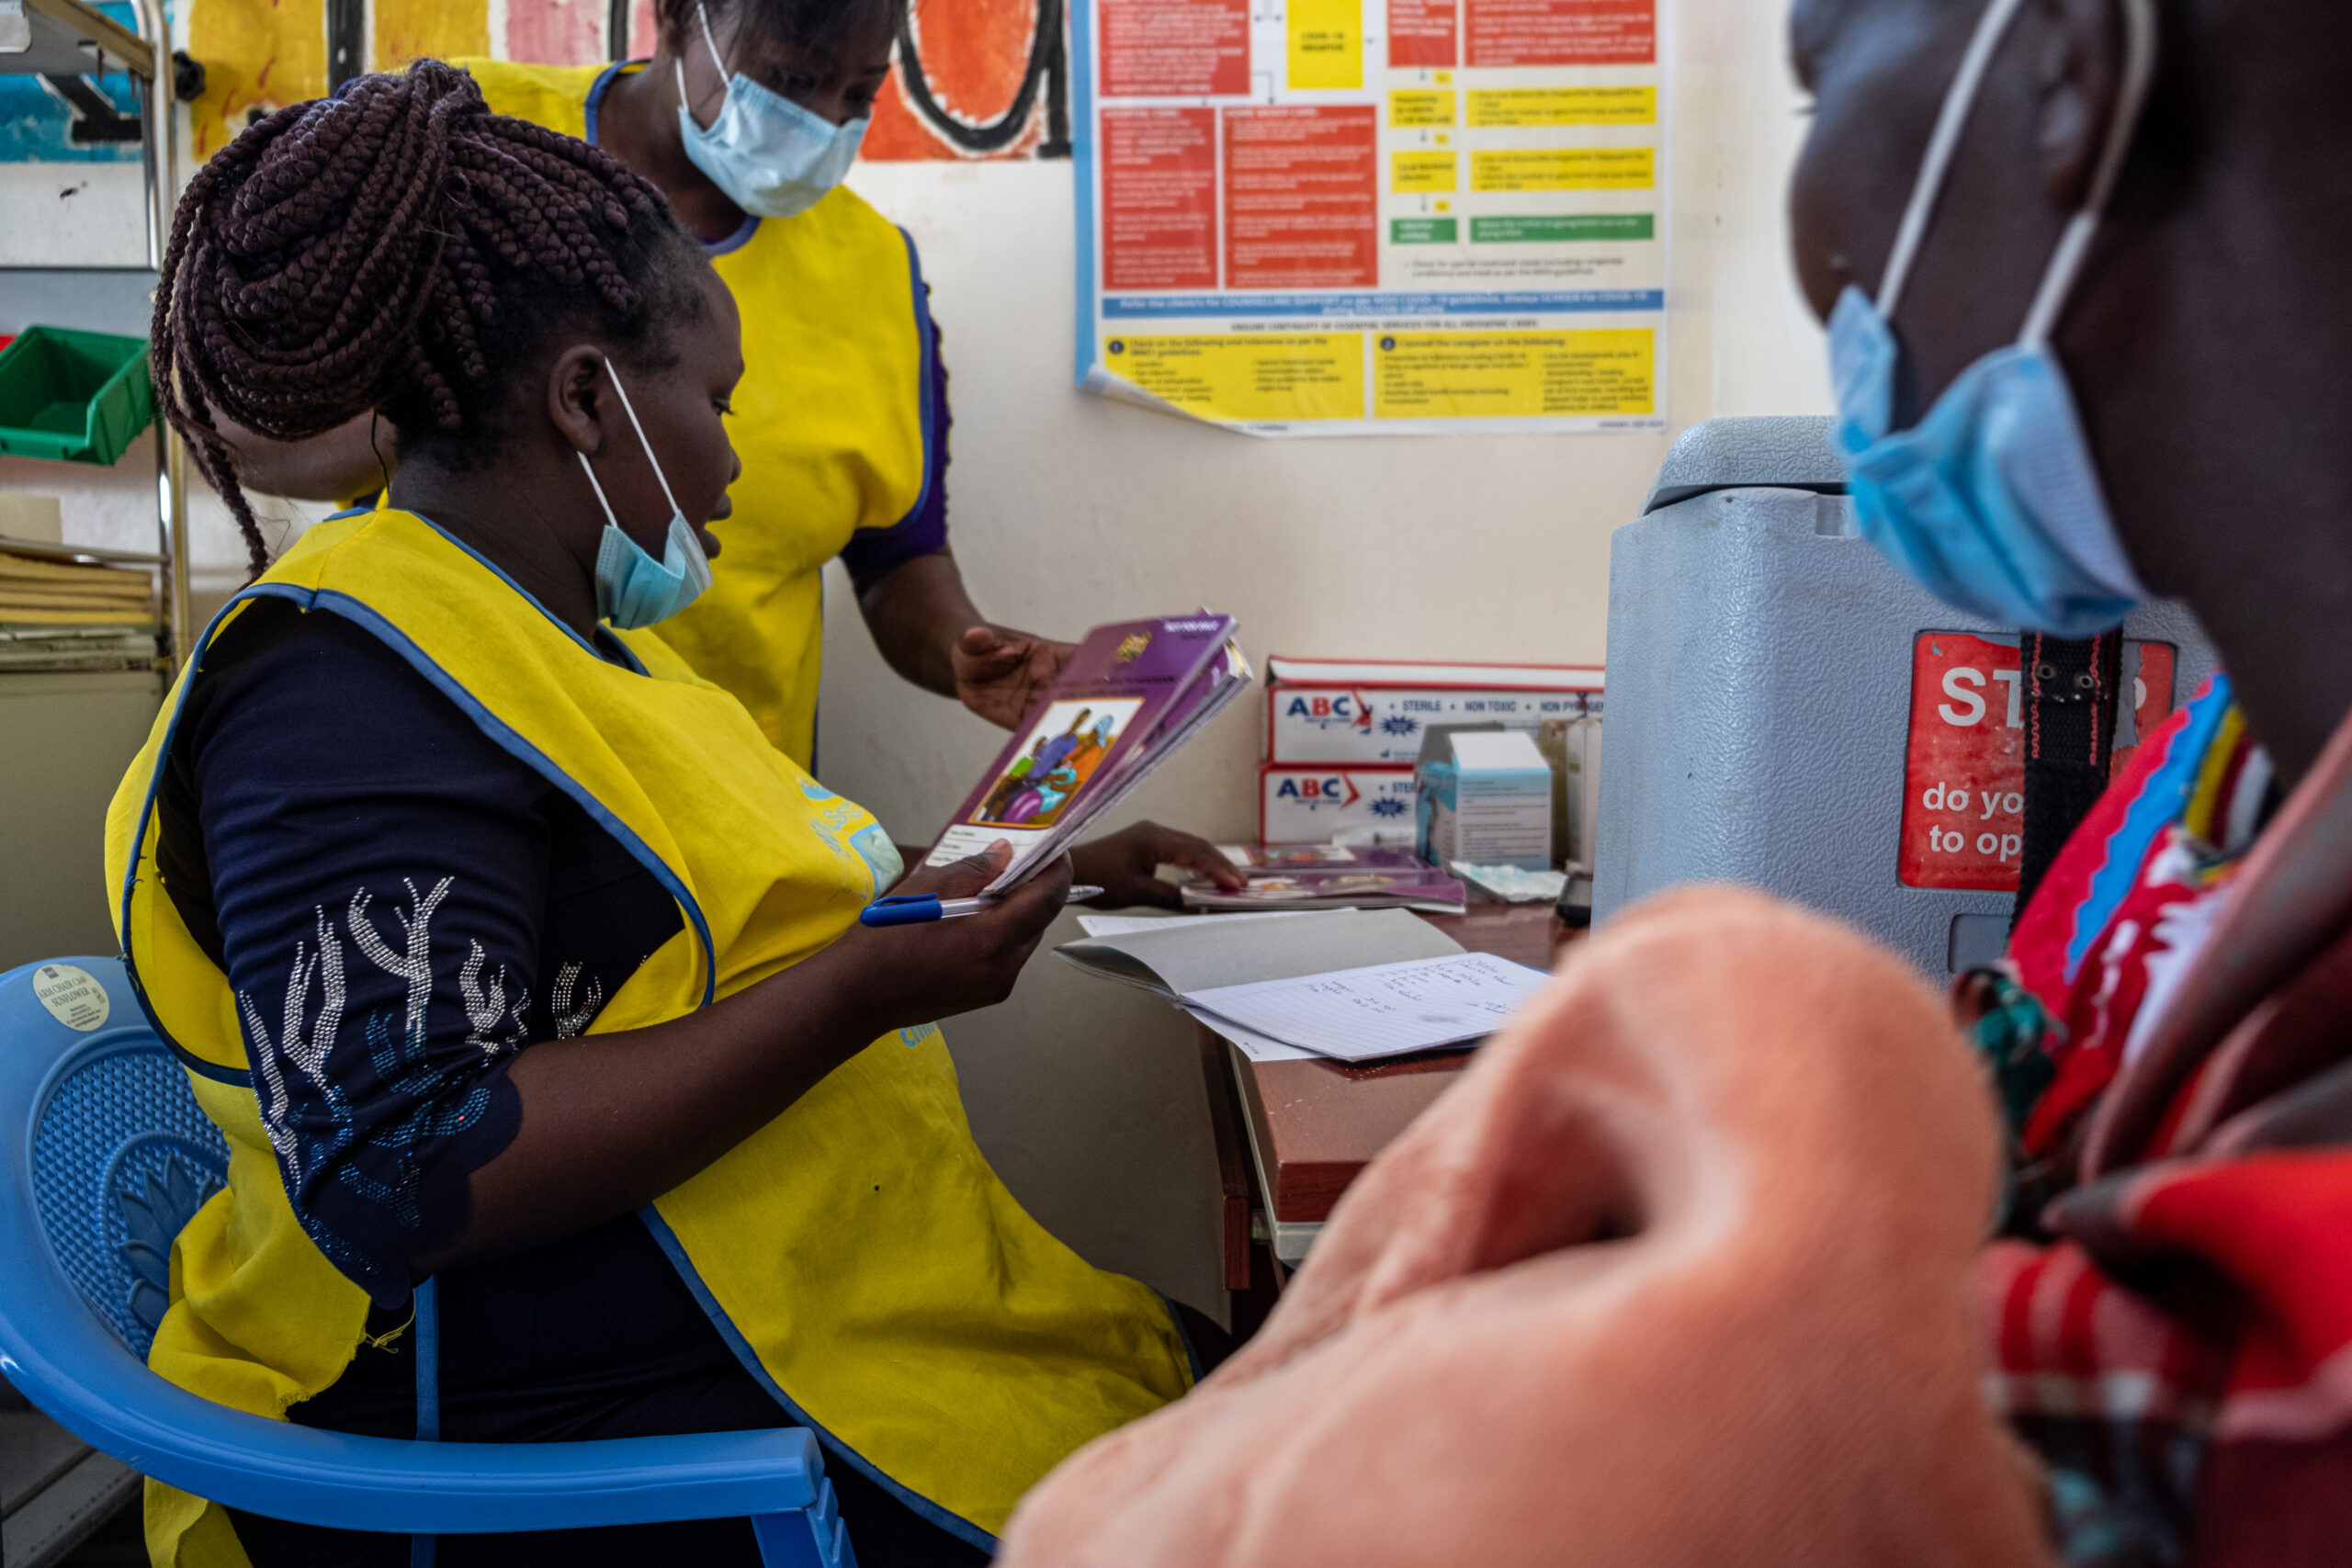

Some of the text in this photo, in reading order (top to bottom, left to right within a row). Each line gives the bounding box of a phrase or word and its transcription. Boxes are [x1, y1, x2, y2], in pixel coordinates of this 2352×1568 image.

[1286, 695, 1351, 717] ABC
[1403, 699, 1442, 712] STERILE
[1464, 700, 1486, 712] NON
[1487, 700, 1517, 713] TOXIC
[1540, 701, 1561, 712] NON
[1276, 778, 1341, 798] ABC
[1922, 782, 1970, 812] do
[1929, 825, 1965, 853] to
[51, 987, 90, 1007] SUNFLOWER
